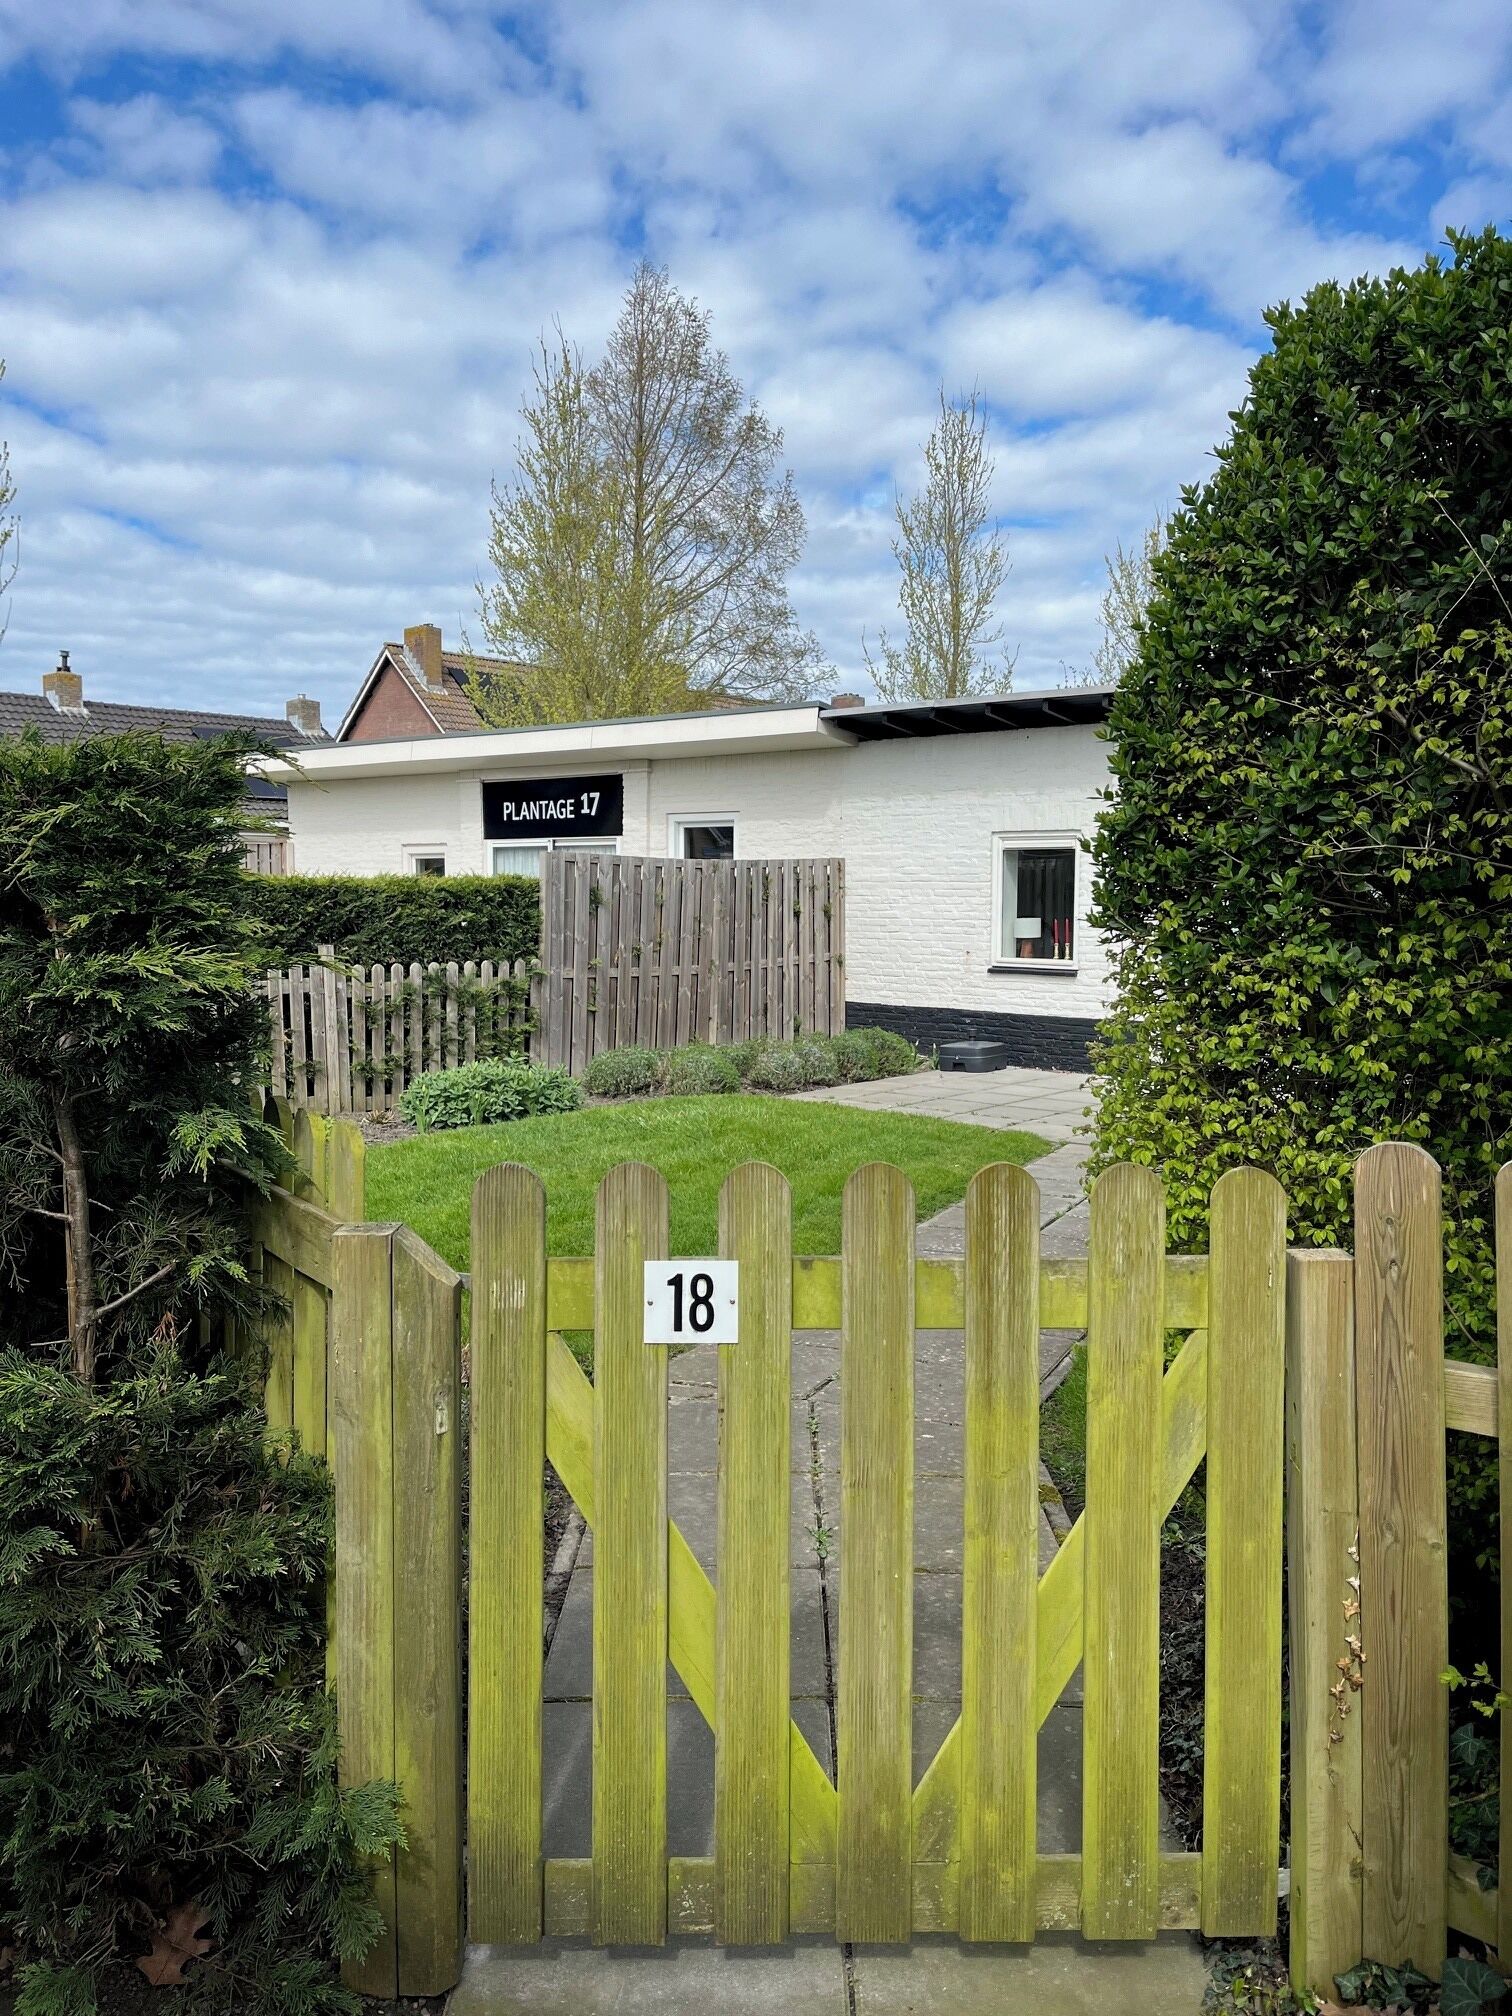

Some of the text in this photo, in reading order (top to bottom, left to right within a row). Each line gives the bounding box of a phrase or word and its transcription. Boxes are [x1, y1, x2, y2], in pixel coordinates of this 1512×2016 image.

[503, 791, 600, 821] PLANTAGE 17
[666, 1273, 715, 1332] 18
